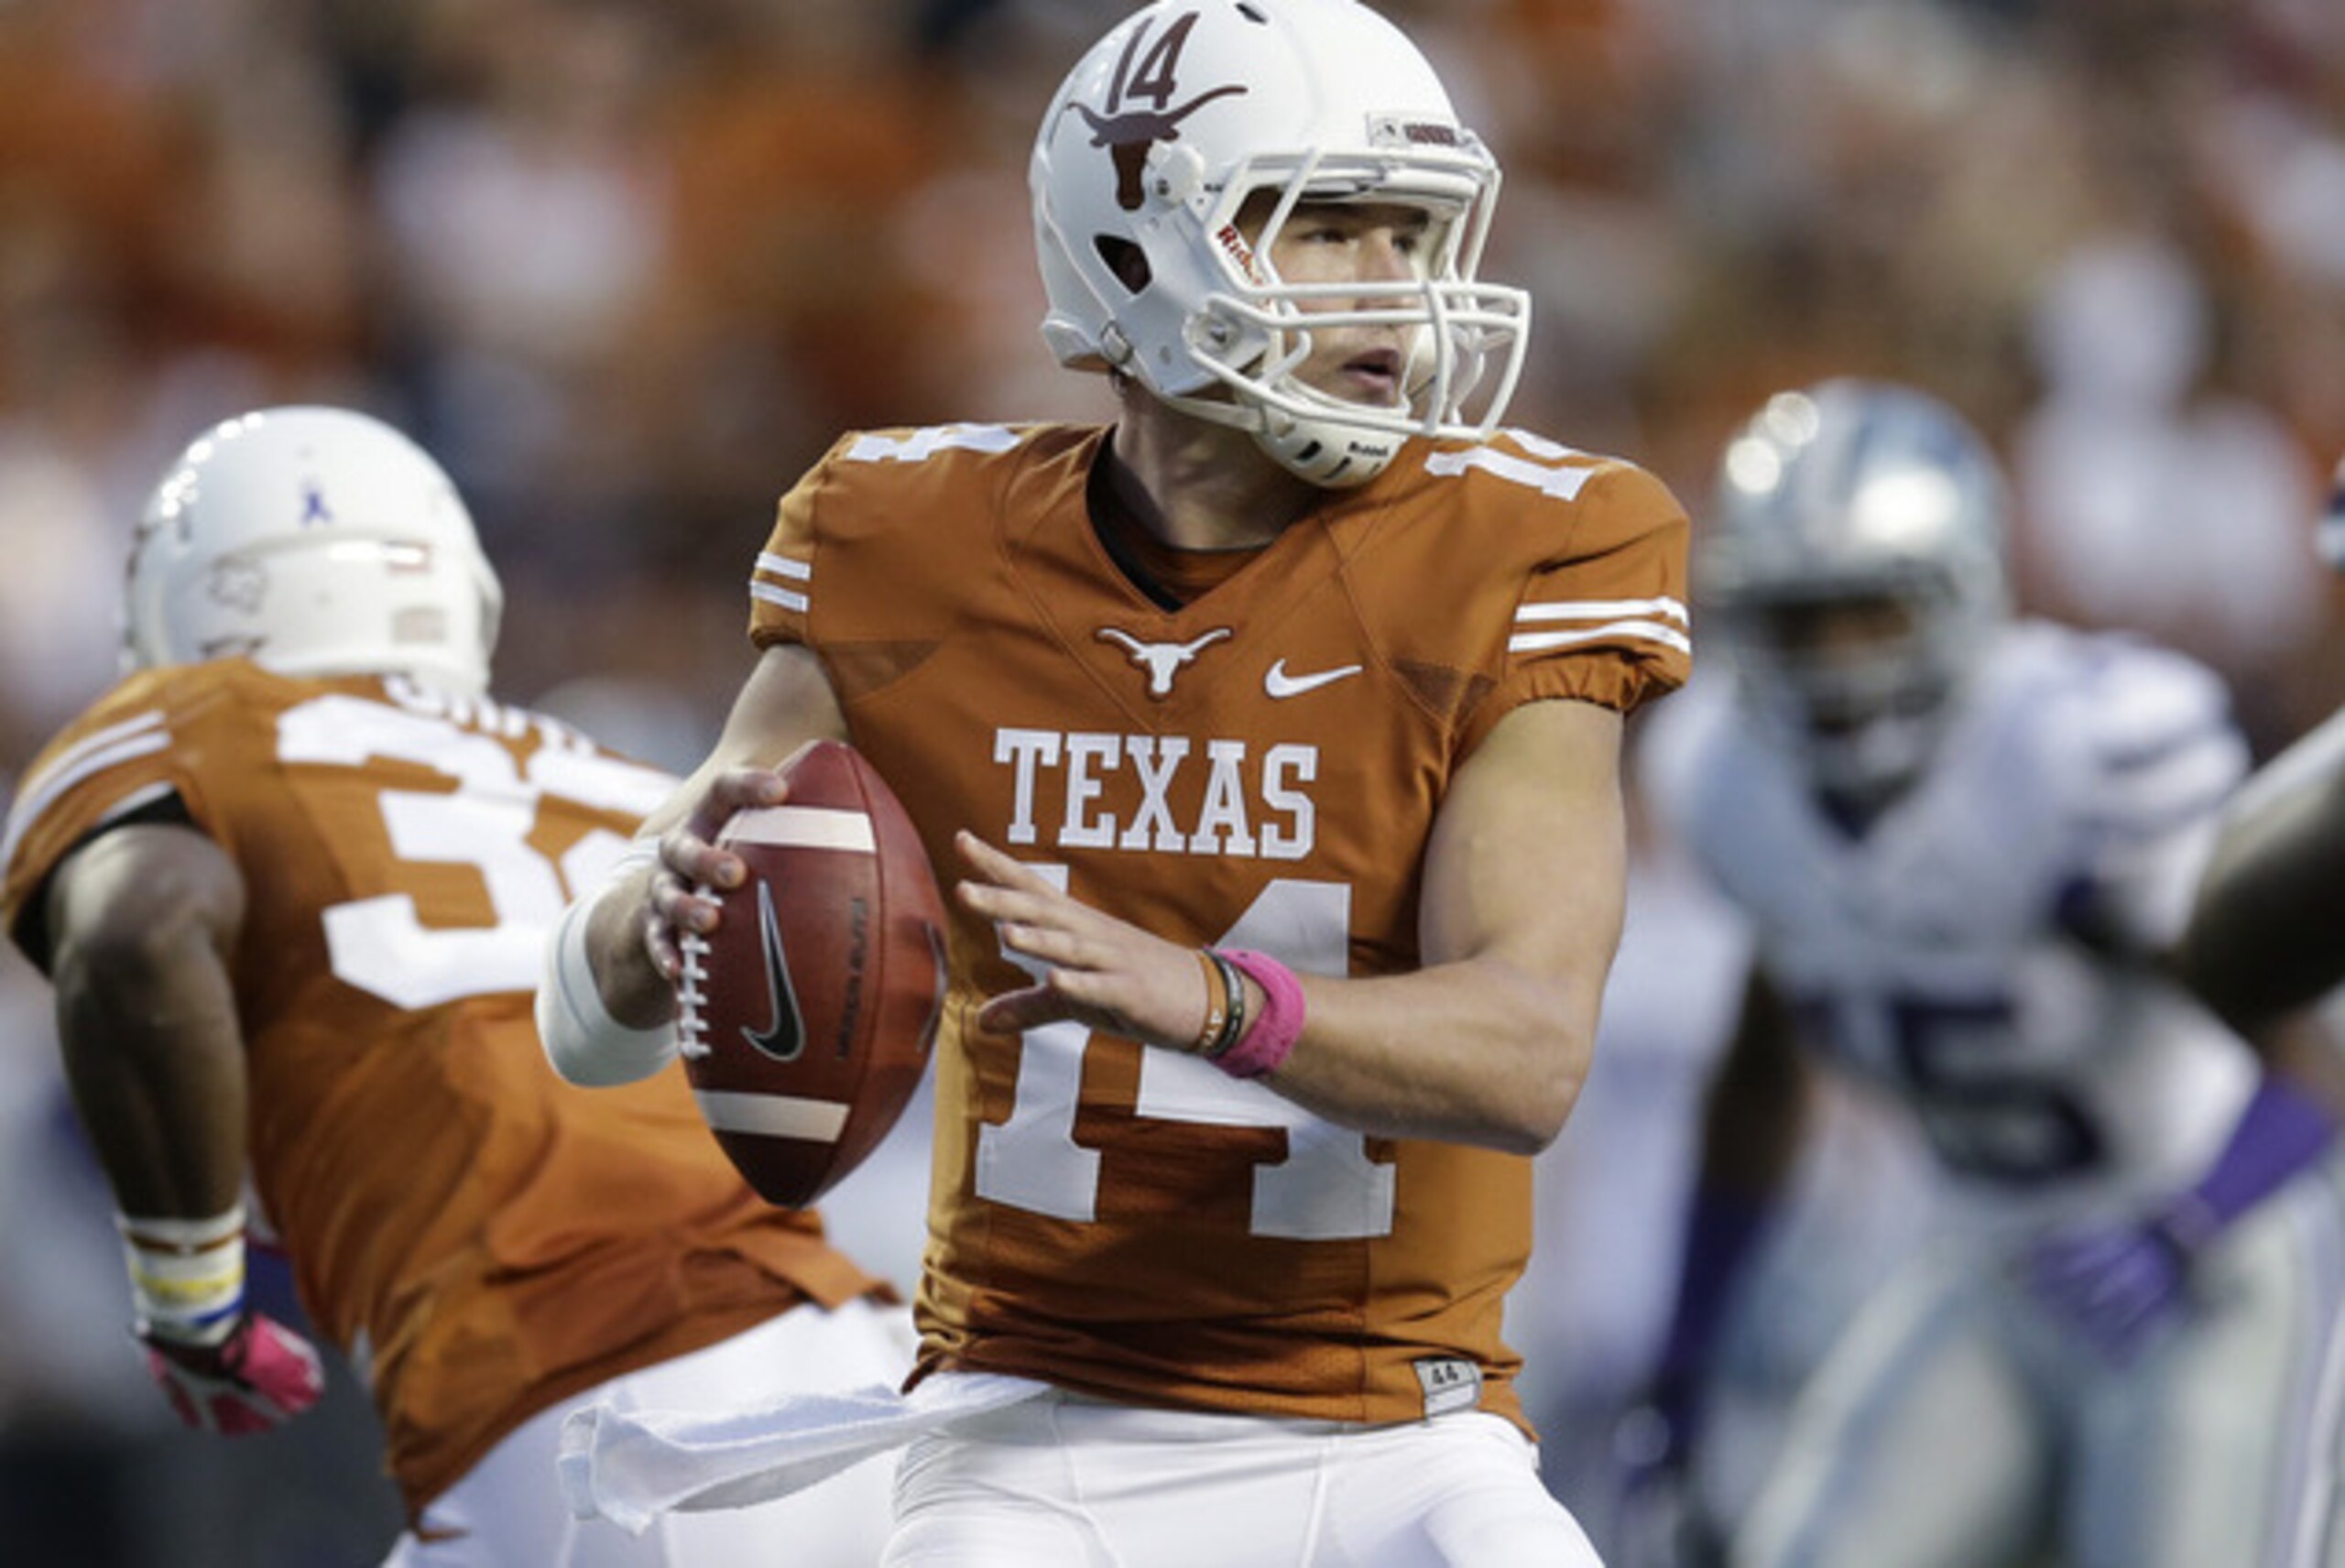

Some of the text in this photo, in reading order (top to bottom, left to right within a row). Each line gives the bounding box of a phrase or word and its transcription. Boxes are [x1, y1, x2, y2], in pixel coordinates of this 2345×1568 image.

[1105, 11, 1200, 114] 14
[994, 727, 1319, 859] TEXAS
[976, 864, 1397, 1240] 14
